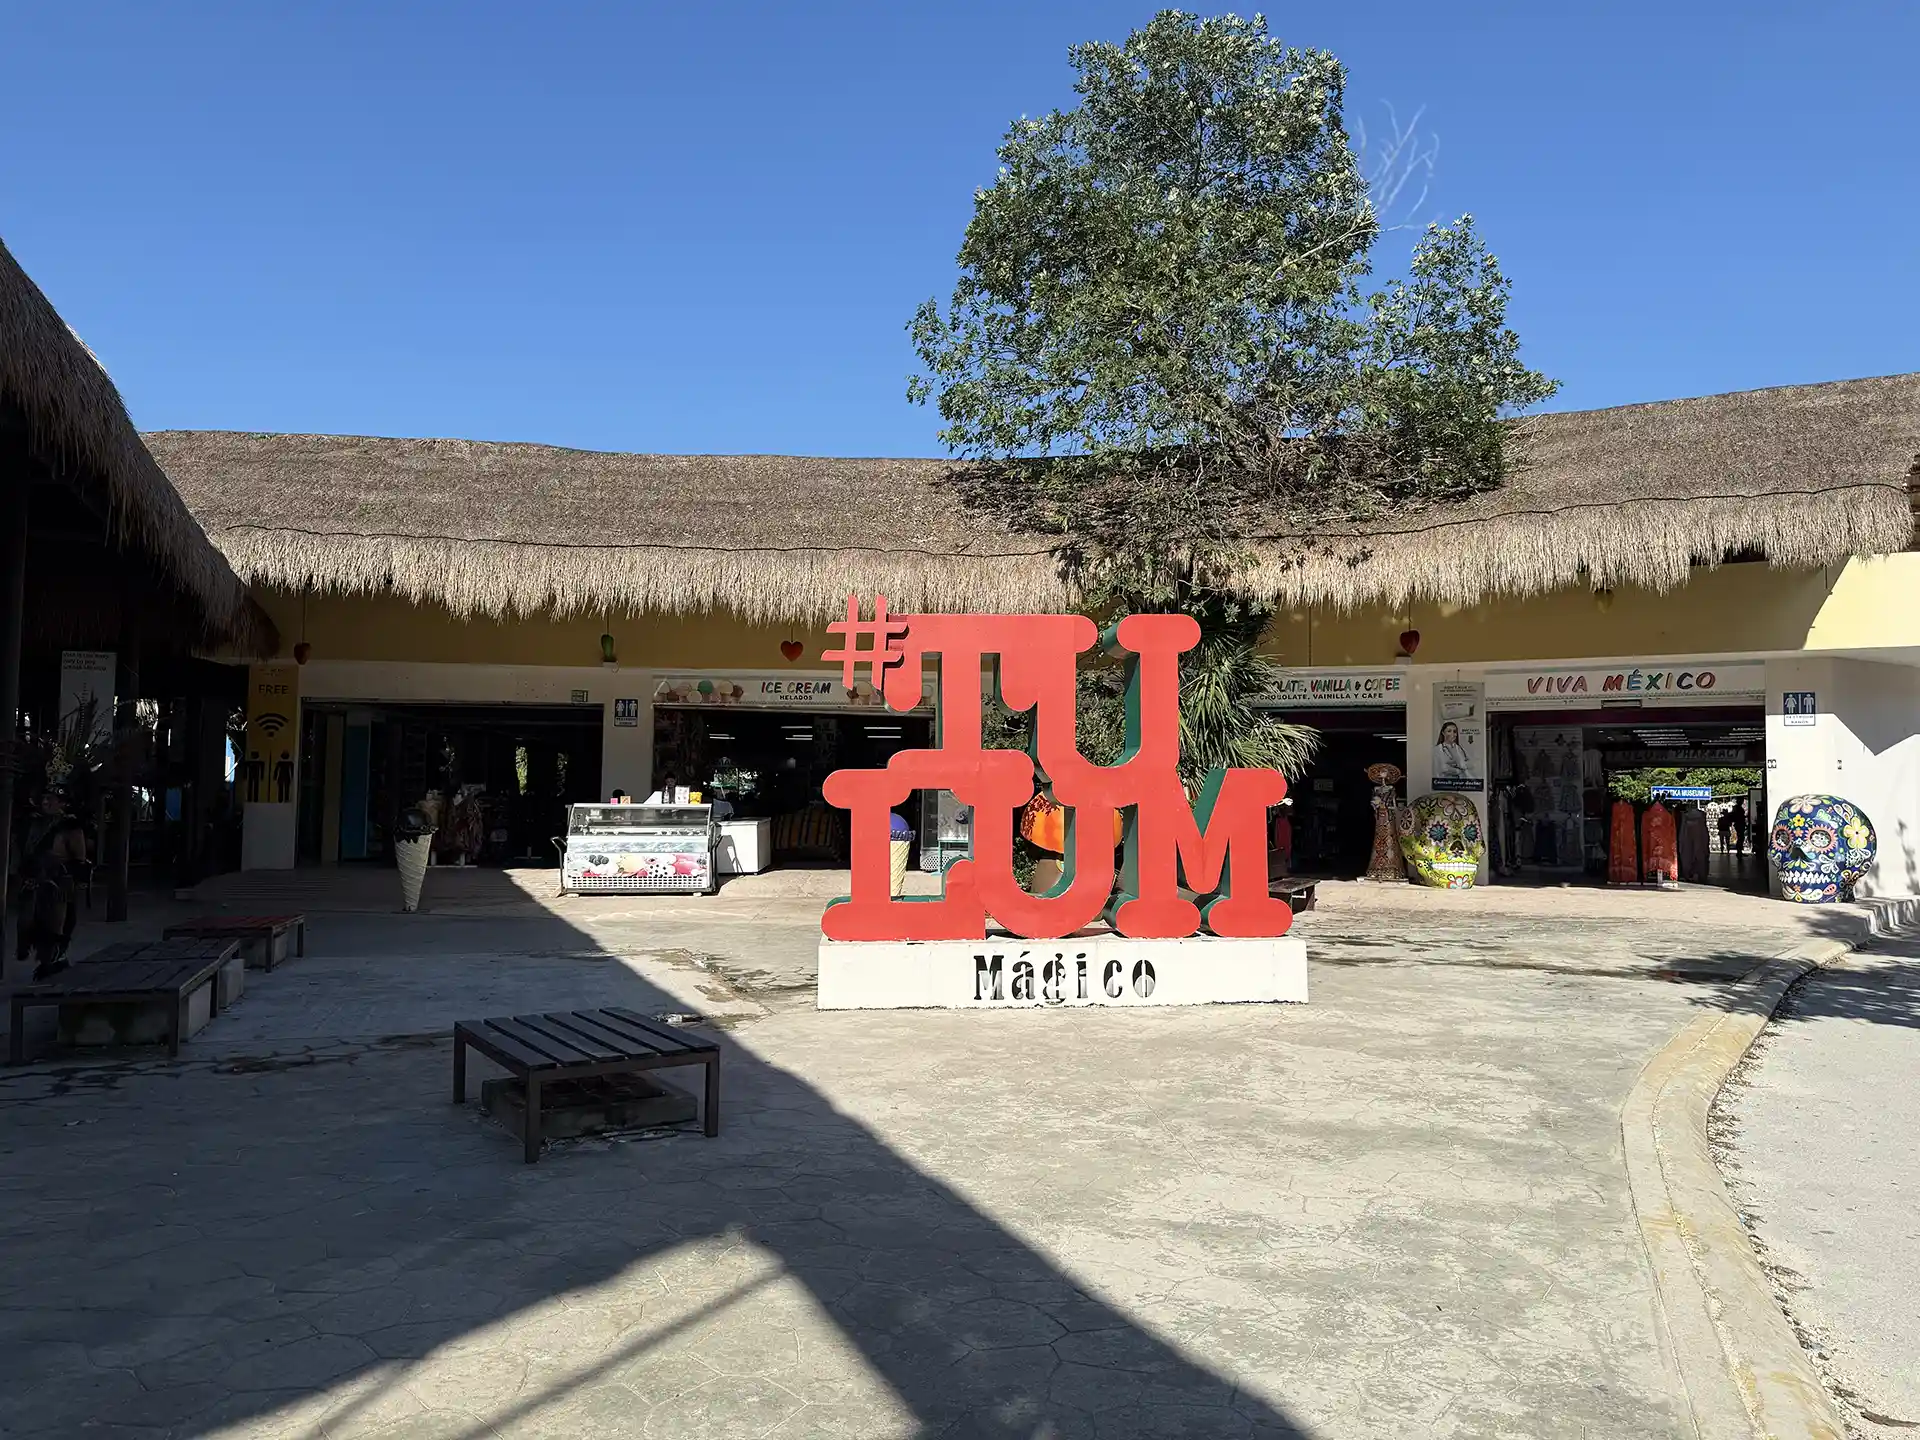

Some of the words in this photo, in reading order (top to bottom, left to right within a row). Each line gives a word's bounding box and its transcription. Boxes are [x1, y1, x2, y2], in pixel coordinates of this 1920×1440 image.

[761, 682, 782, 694] ICE
[787, 682, 832, 694] CREAM
[1310, 678, 1351, 692] VANILLA
[1527, 675, 1588, 694] VIVA
[1602, 669, 1716, 692] MÉXICO
[259, 684, 289, 695] FREE
[1674, 749, 1740, 760] PHARMACY
[973, 951, 1156, 1006] Mágico
